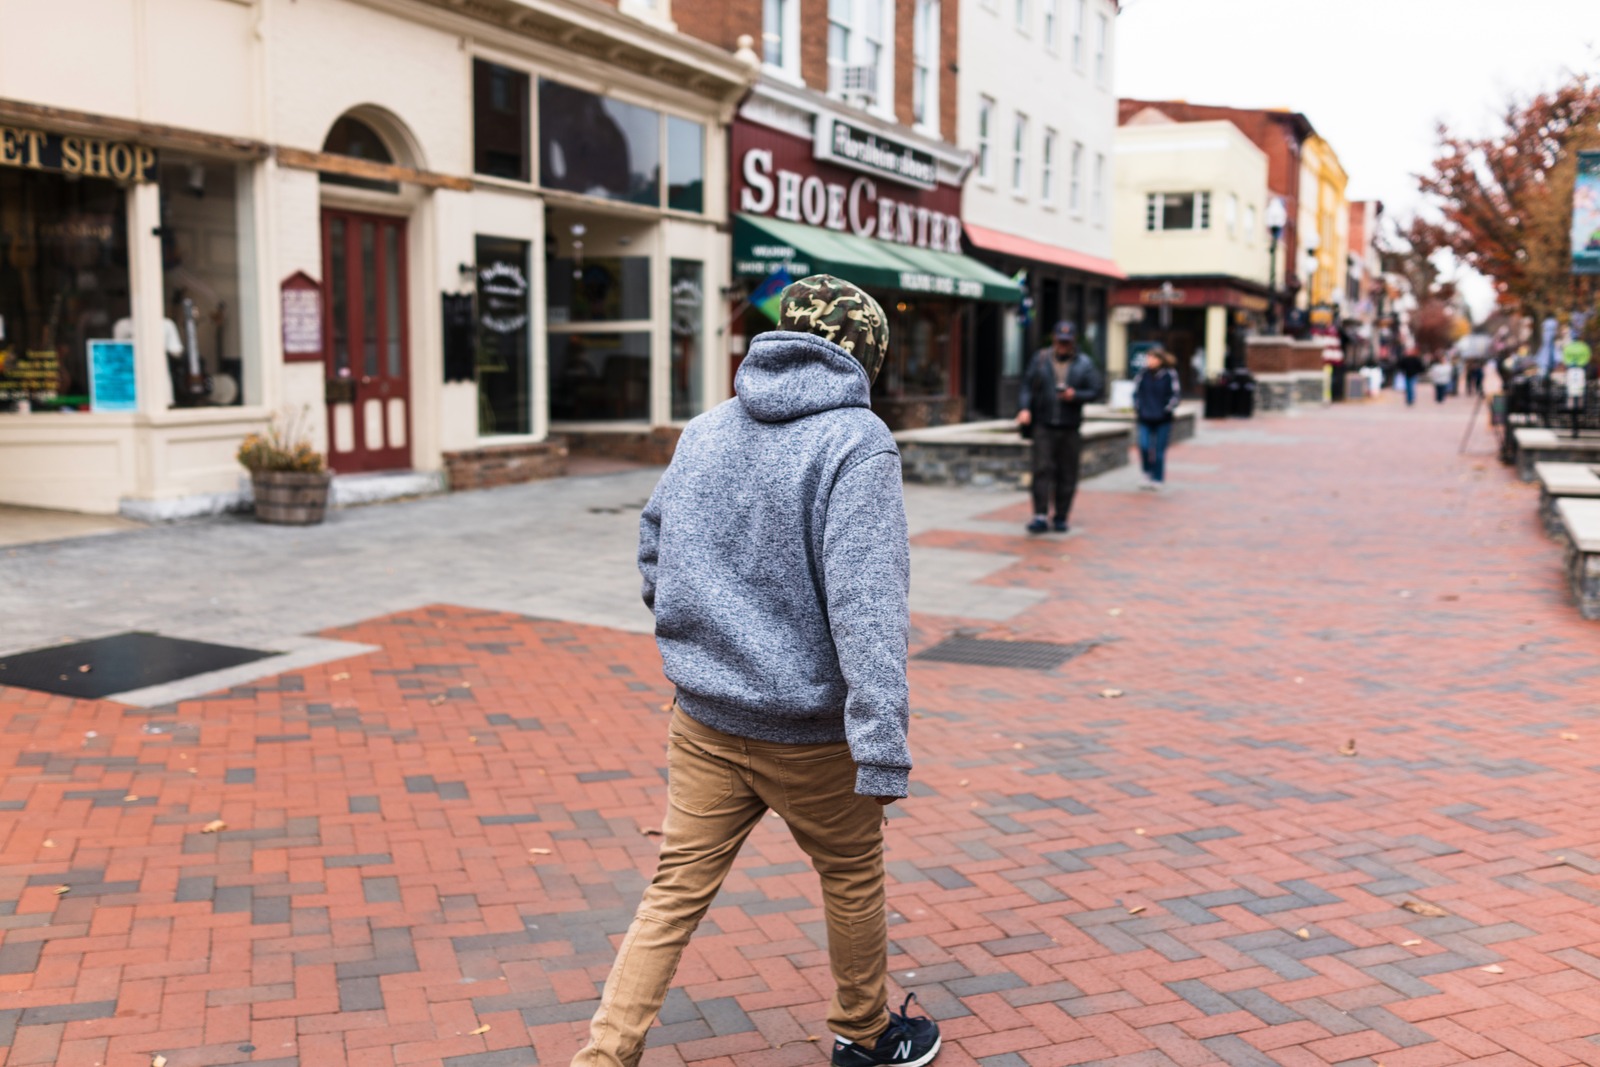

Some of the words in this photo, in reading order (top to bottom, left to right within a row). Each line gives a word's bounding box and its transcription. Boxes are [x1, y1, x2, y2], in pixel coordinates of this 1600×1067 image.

[61, 136, 154, 181] SHOP
[741, 148, 846, 230] SHOE
[849, 177, 962, 253] CENTER
[893, 1040, 911, 1059] N
